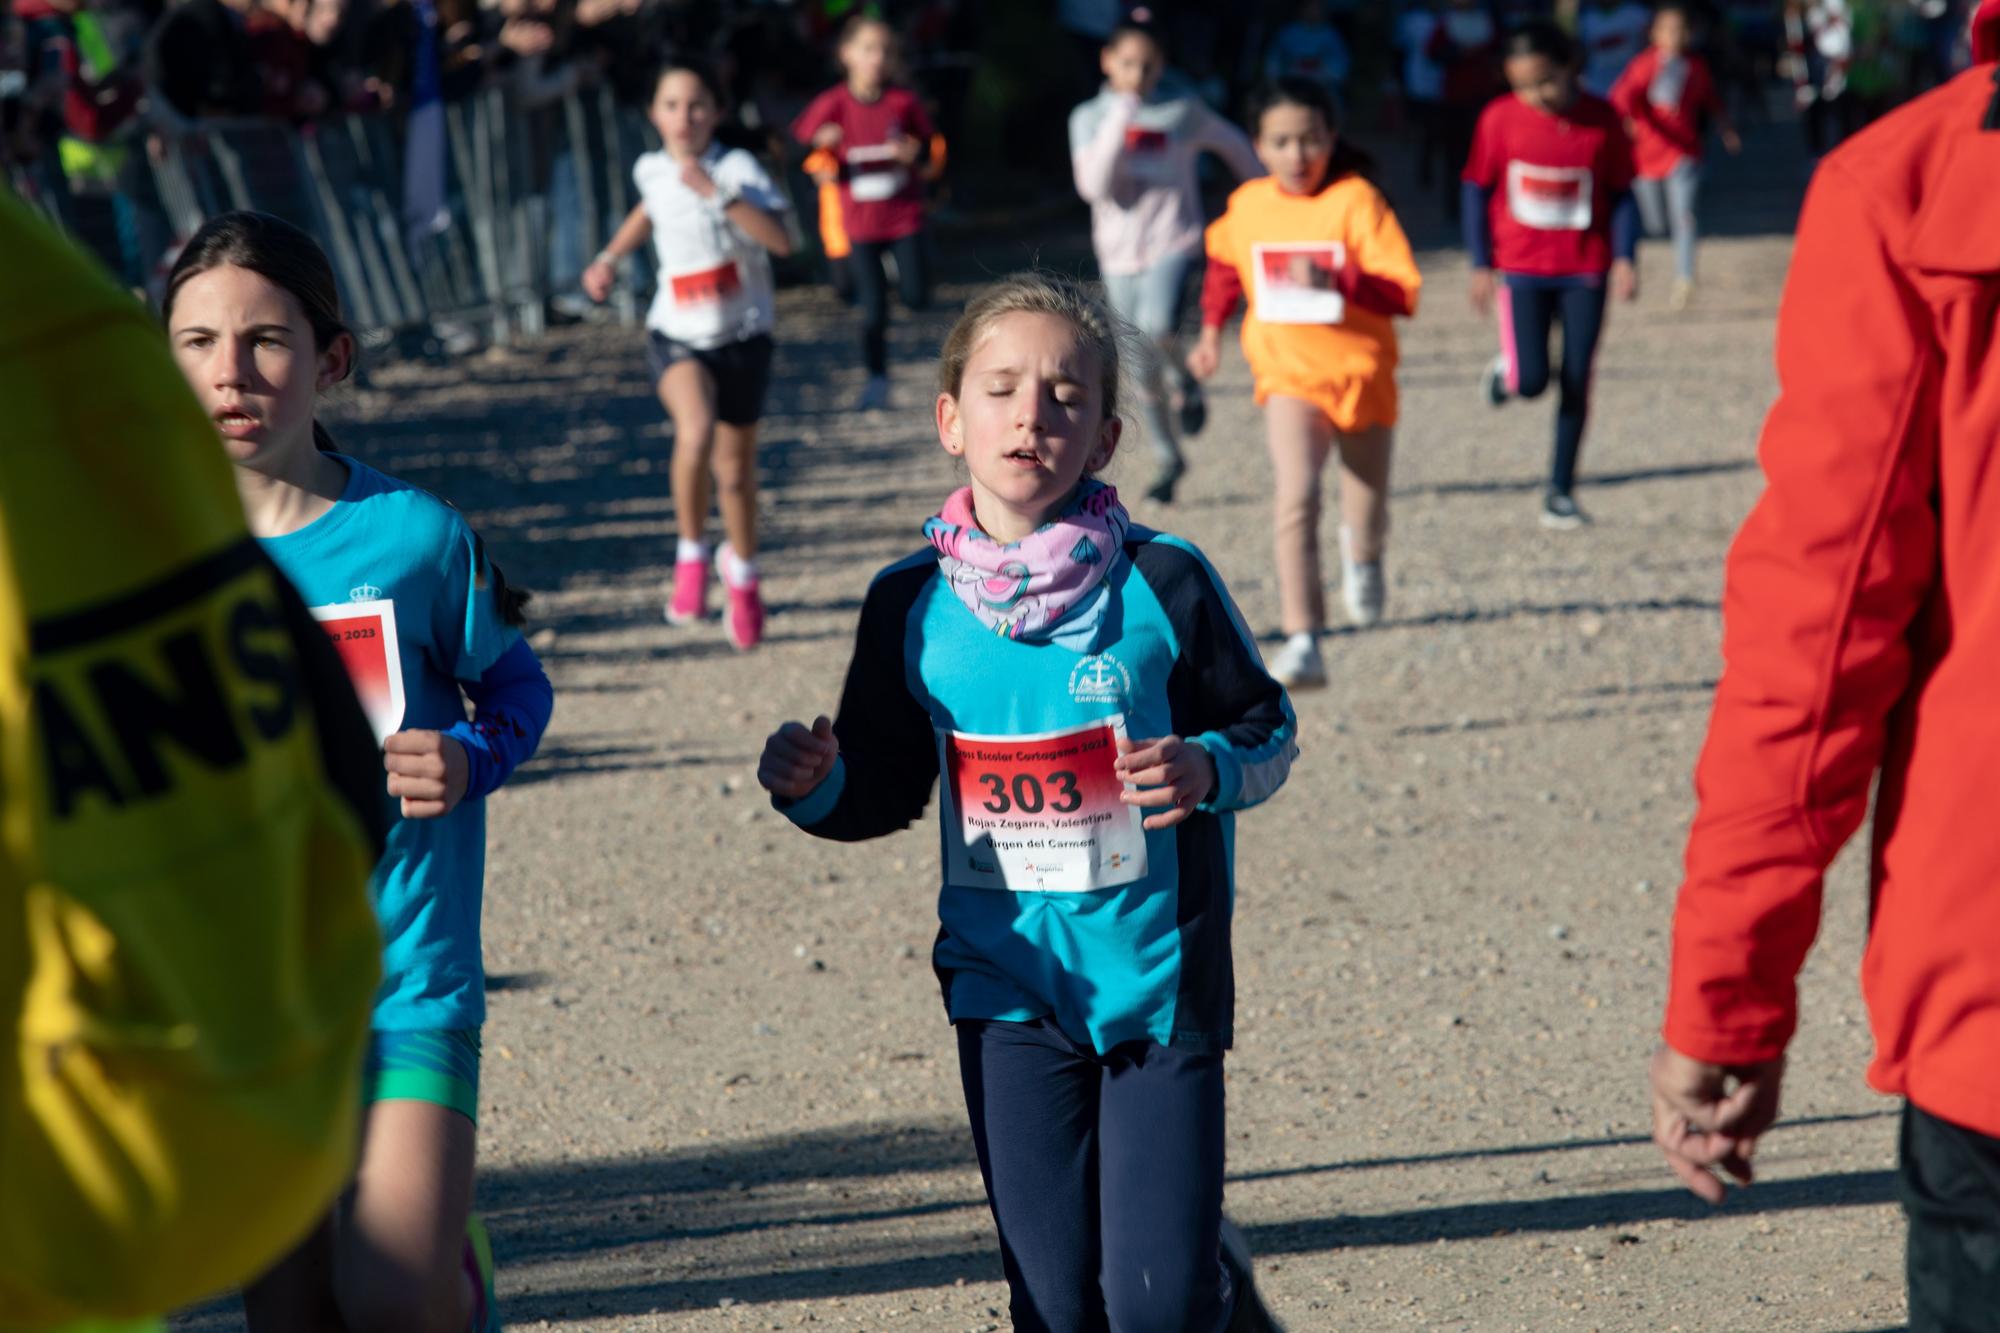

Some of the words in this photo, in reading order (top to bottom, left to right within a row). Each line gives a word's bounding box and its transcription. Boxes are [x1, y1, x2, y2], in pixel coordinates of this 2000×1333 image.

[344, 628, 376, 641] 2023
[977, 750, 1013, 762] Escolar
[979, 770, 1083, 814] 303
[967, 816, 996, 829] Rojas
[999, 819, 1050, 831] Zegarra,
[1052, 812, 1113, 828] Valentina
[985, 838, 1024, 850] Virgen
[1026, 838, 1045, 849] del
[1048, 838, 1096, 849] Carmen
